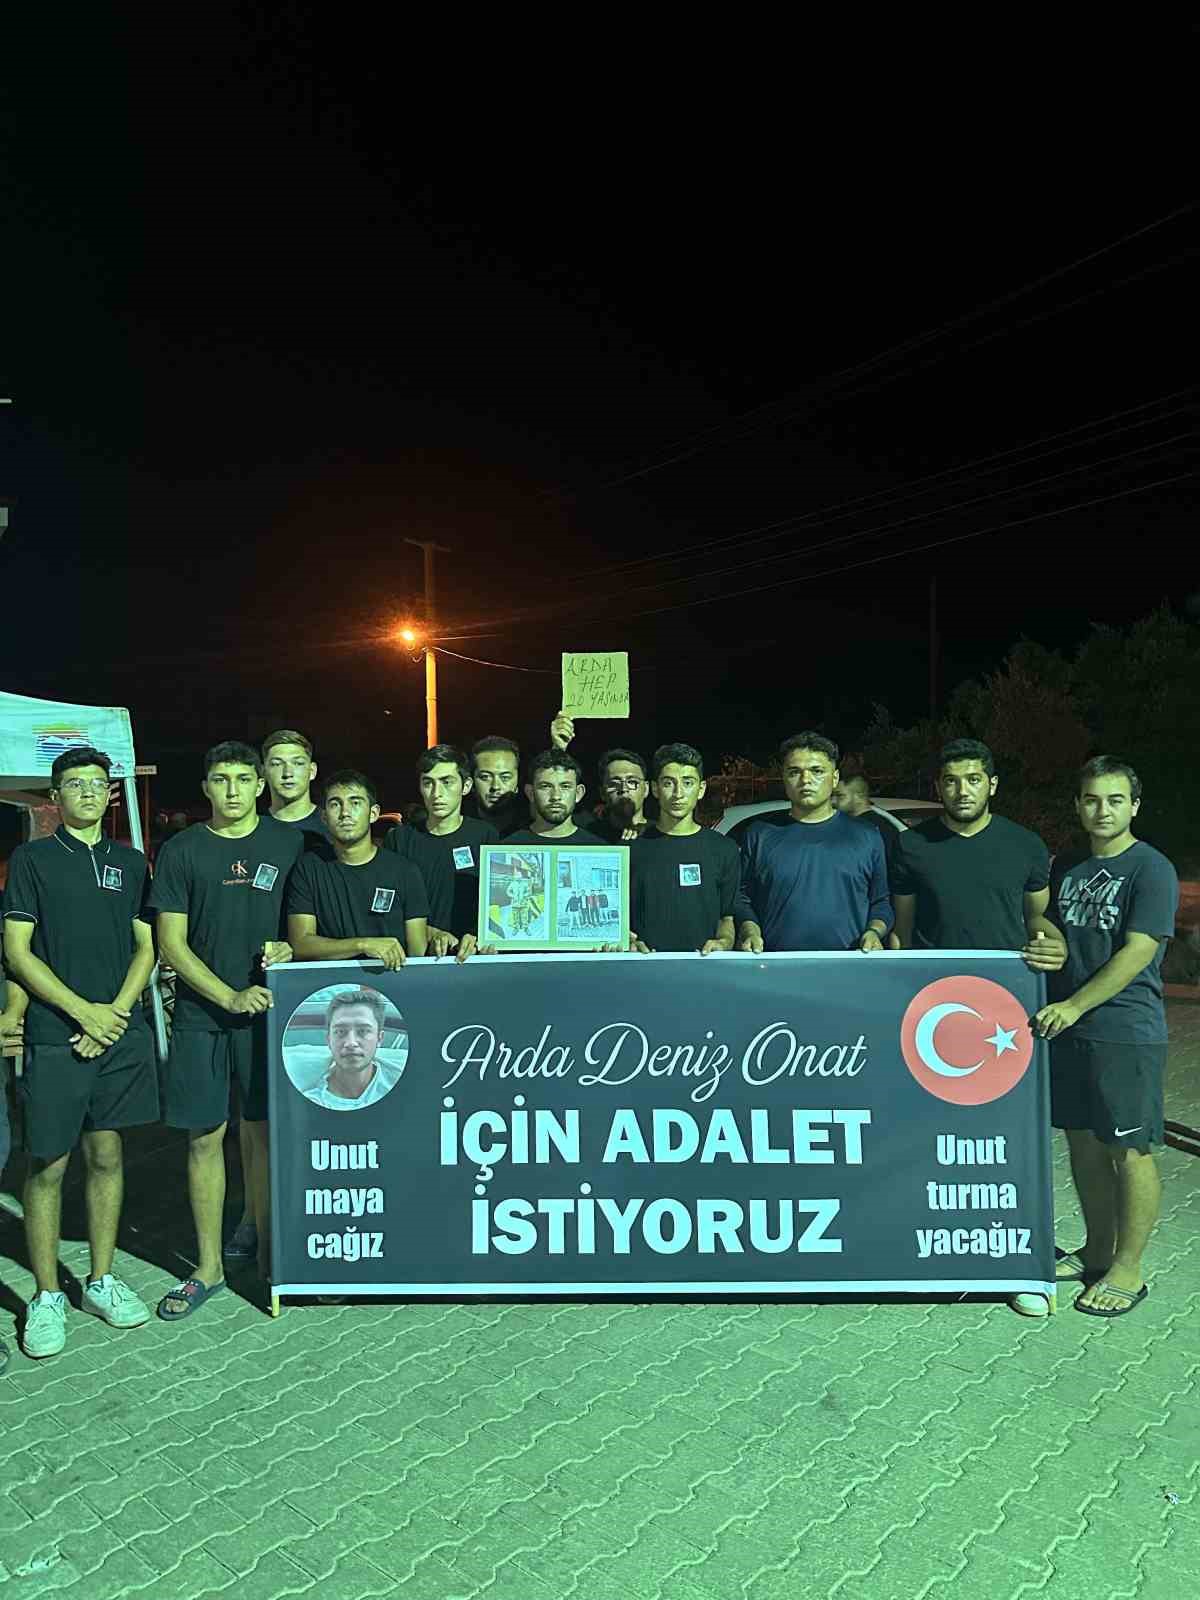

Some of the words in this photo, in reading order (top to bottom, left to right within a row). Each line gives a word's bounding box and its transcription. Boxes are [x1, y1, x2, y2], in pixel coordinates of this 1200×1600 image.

[578, 672, 617, 691] HEP
[441, 1024, 575, 1089] Arda
[578, 1022, 733, 1103] Deniz
[741, 1021, 867, 1086] Onat
[311, 1139, 379, 1171] Unut
[440, 1095, 581, 1181] İÇİN
[602, 1108, 872, 1165] ADALET
[936, 1134, 1007, 1166] Unut
[305, 1187, 384, 1217] maya
[926, 1180, 1017, 1210] turma
[471, 1182, 843, 1255] İSTİYORUZ
[307, 1226, 384, 1262] cağız
[915, 1221, 1032, 1258] yacağız
